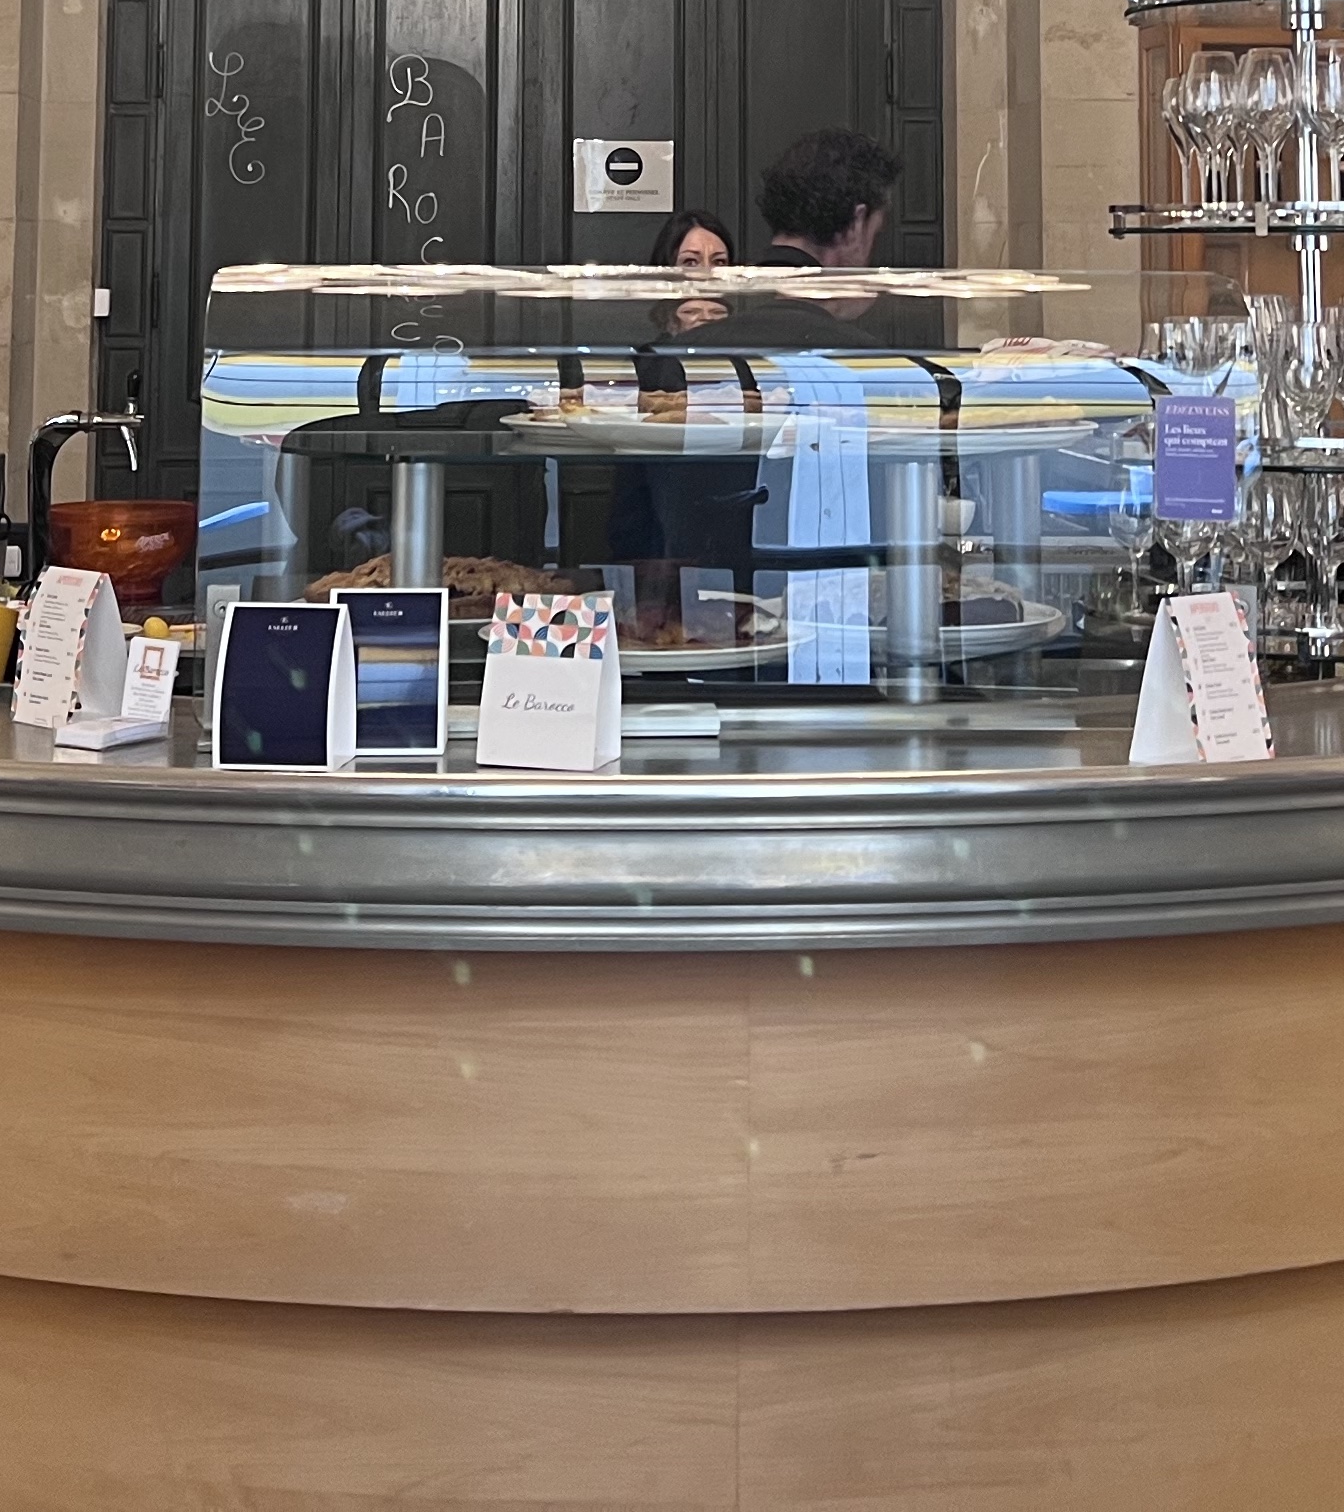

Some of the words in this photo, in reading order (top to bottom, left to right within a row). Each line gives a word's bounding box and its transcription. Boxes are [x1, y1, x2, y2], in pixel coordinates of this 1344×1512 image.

[1165, 423, 1182, 434] Les
[1164, 435, 1181, 448] qui
[501, 692, 520, 710] Le
[523, 693, 575, 713] Barocco
